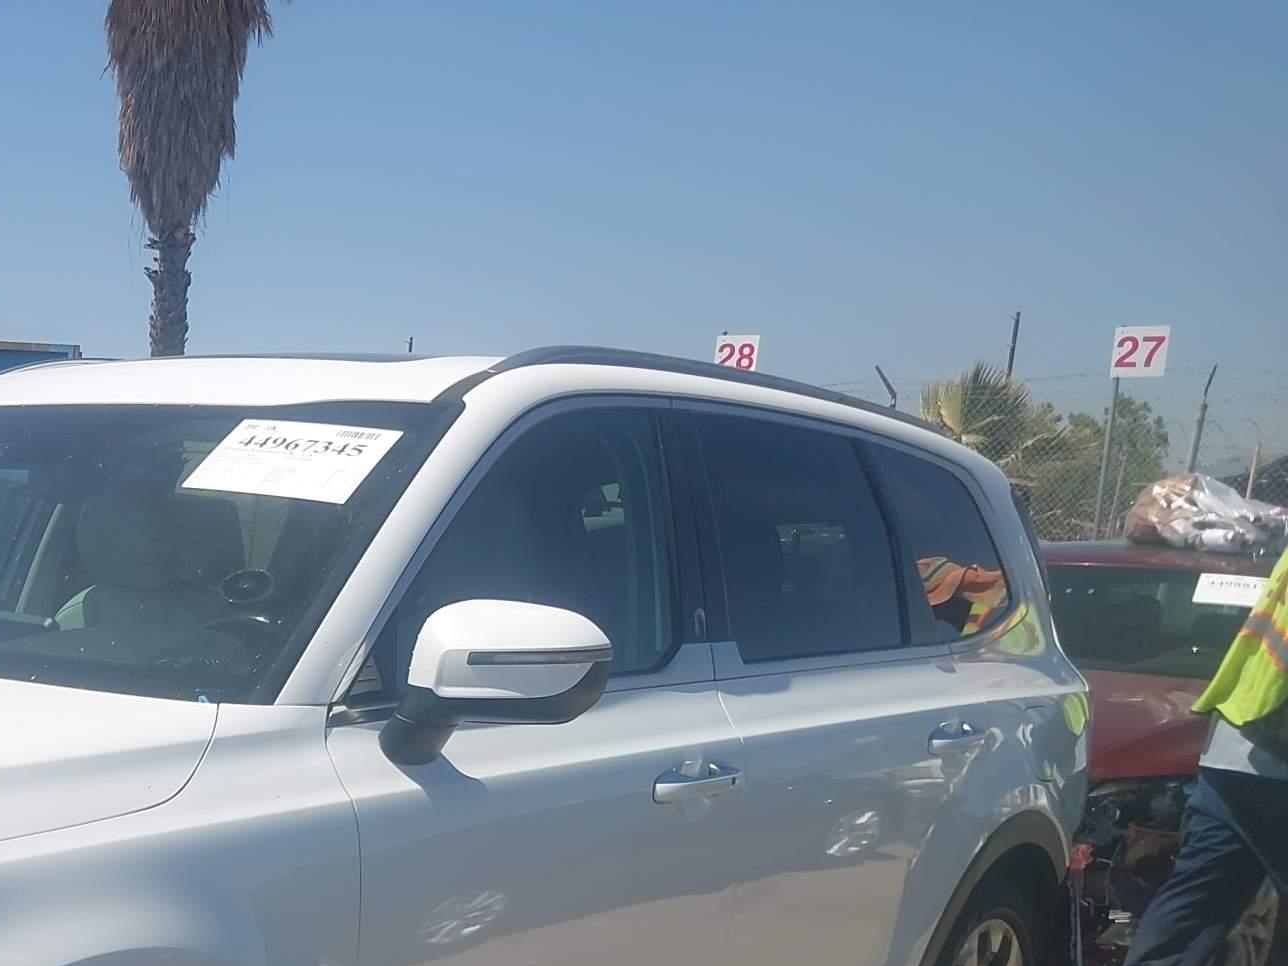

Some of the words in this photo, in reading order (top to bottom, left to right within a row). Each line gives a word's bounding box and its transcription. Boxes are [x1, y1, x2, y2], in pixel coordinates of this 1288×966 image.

[717, 343, 755, 369] 28
[1114, 336, 1166, 368] 27
[238, 435, 368, 457] 44967345
